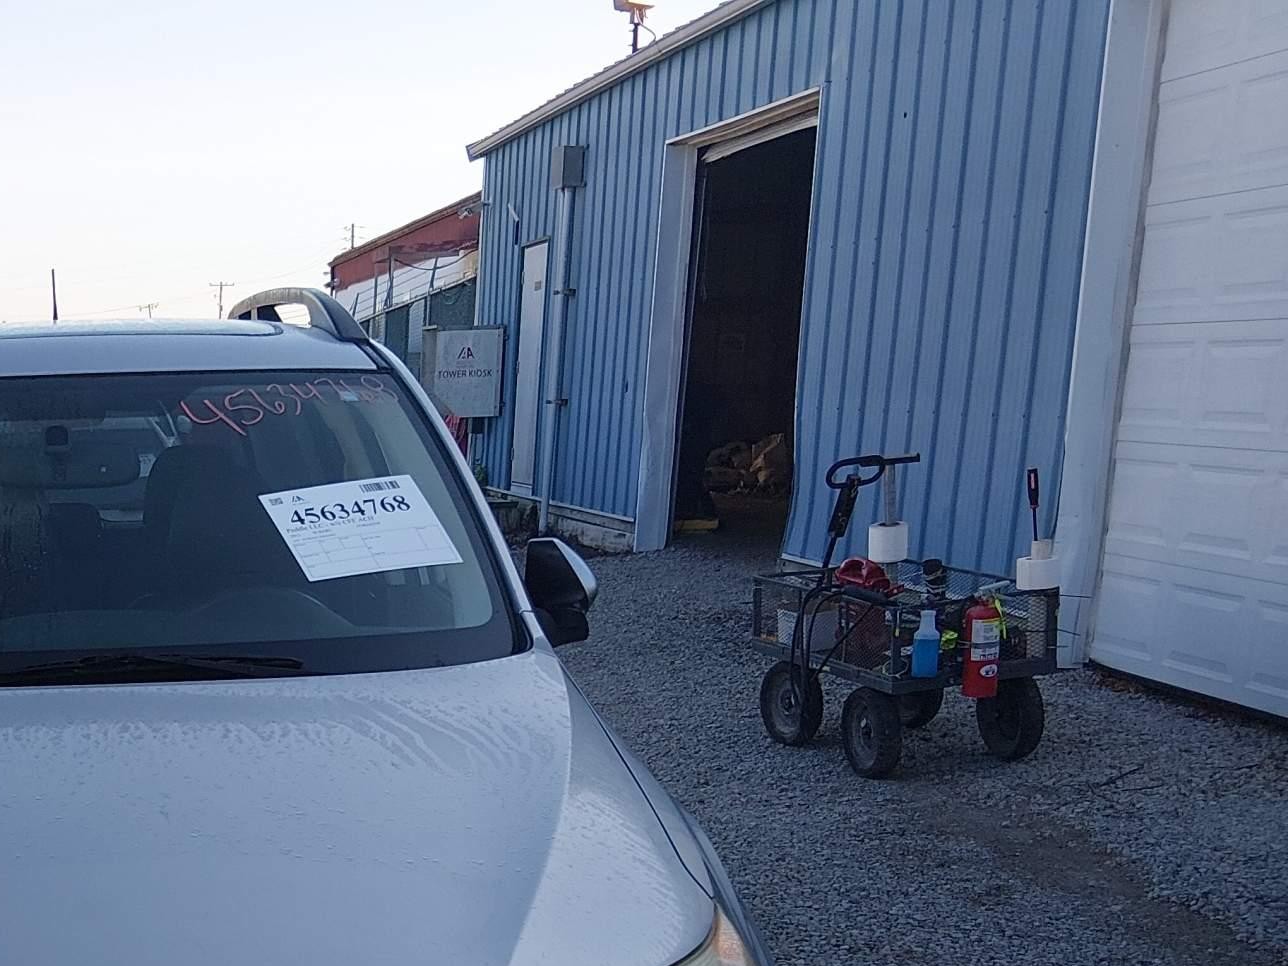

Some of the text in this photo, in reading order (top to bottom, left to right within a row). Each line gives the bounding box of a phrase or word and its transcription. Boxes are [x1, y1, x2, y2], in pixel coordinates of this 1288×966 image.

[438, 369, 493, 379] TOWER KIOSK
[290, 495, 411, 526] 45634768
